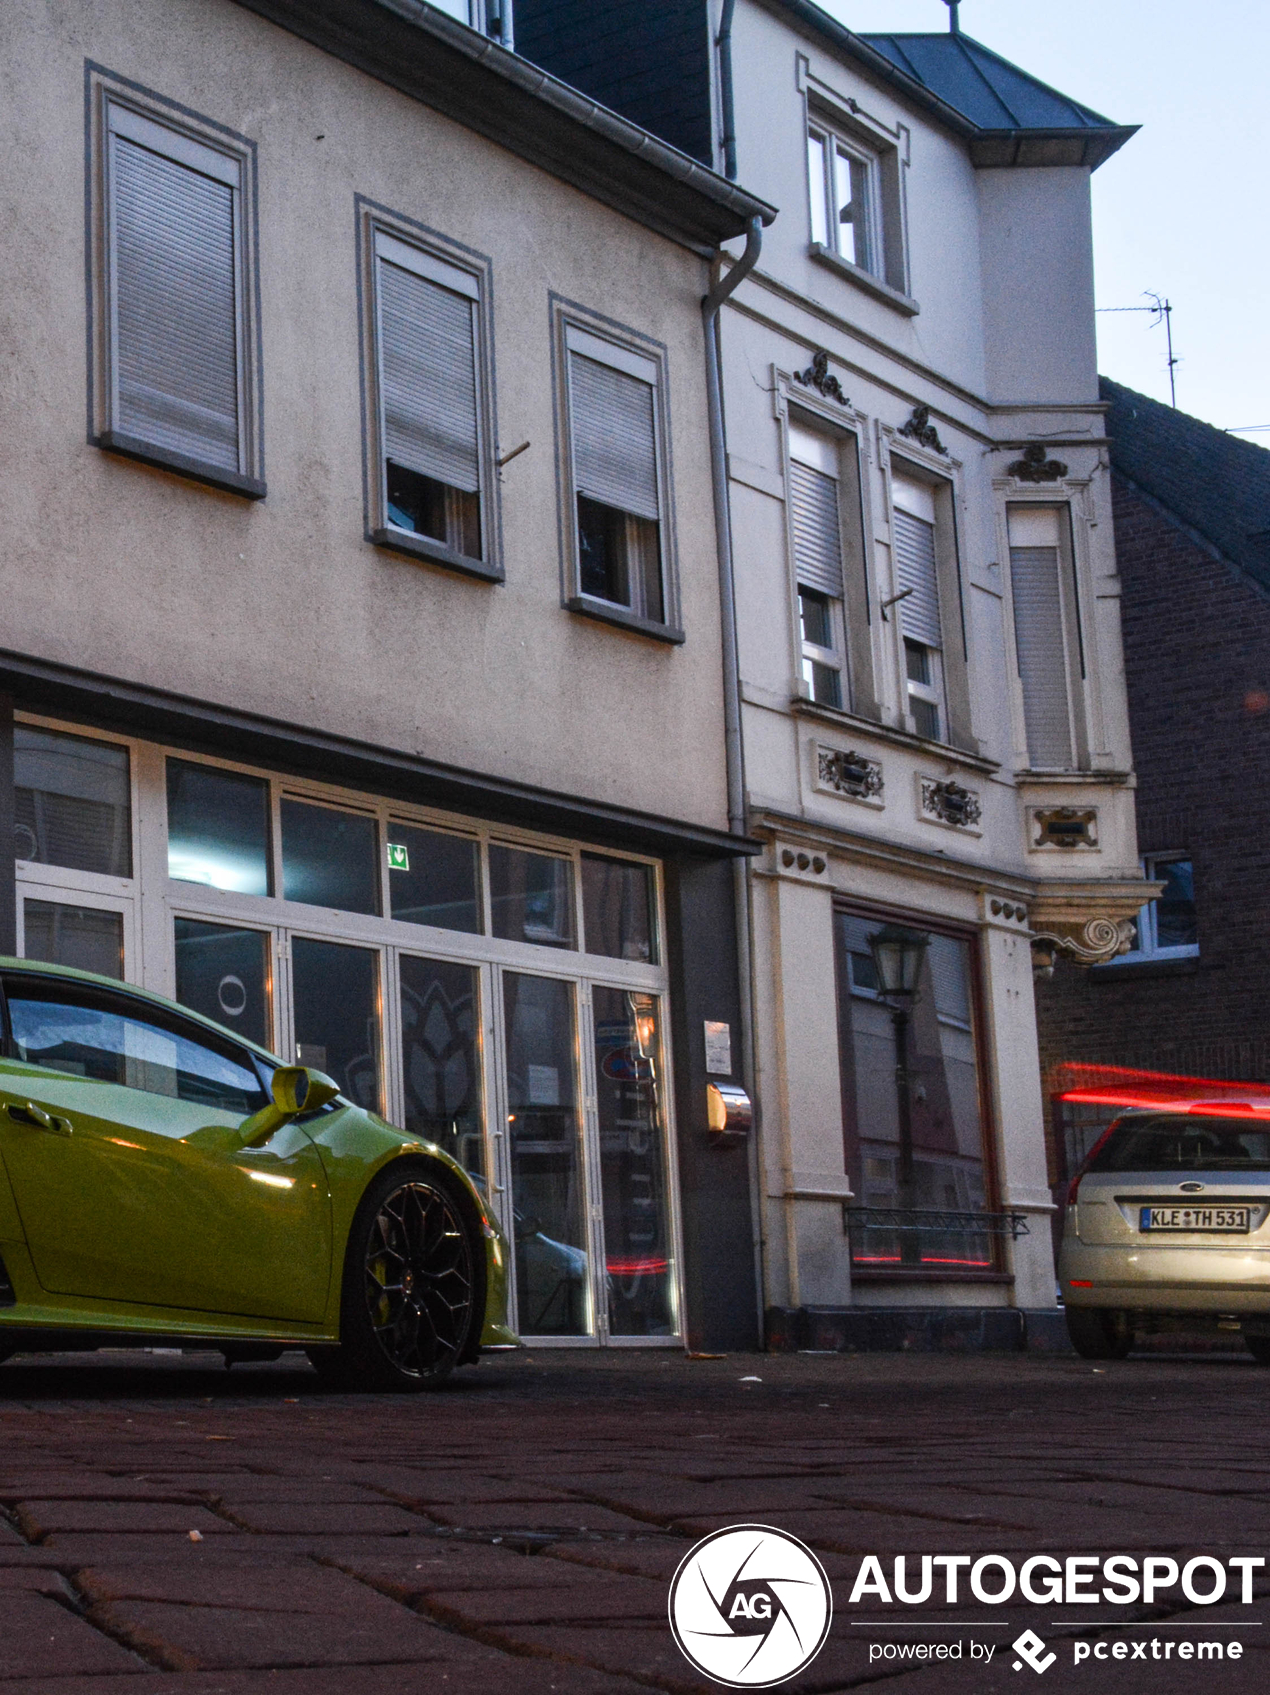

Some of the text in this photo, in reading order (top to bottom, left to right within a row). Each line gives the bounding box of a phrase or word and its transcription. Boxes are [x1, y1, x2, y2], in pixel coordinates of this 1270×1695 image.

[1151, 1210, 1246, 1227] KLE TH 531
